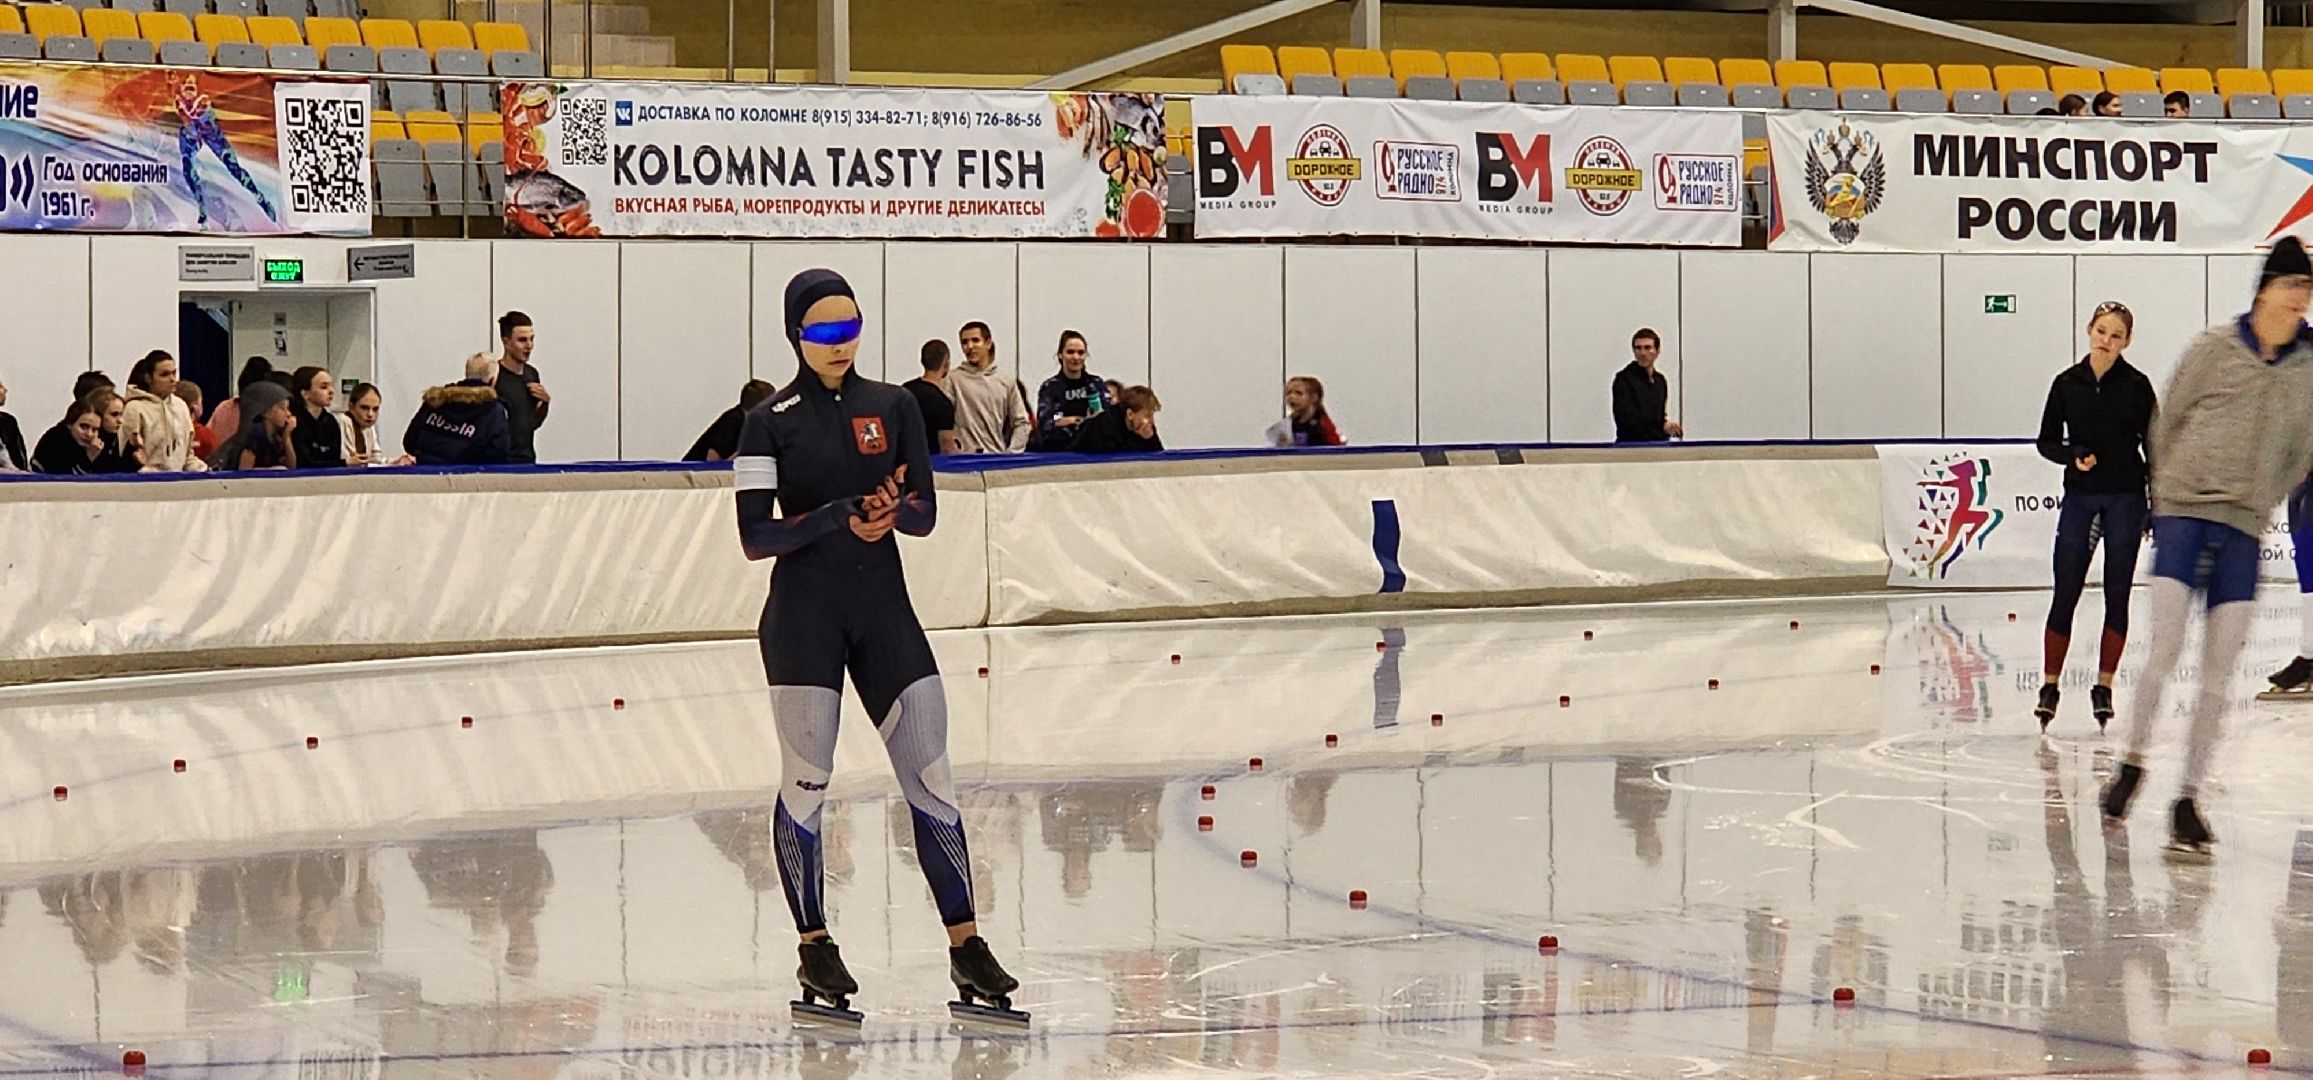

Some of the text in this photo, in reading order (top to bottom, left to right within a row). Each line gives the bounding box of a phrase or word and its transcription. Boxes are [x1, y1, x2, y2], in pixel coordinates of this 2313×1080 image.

[0, 85, 38, 118] ие
[637, 105, 1042, 128] ДОСТАВКА ПО КОЛОМНЕ 8(915) 334-82-71; 8(916) 726-86-56
[44, 156, 168, 183] Год основания
[614, 144, 1045, 190] KOLOMNA TASTY FISH
[1397, 148, 1444, 171] РУССКОЕ
[1914, 134, 2218, 183] МИНСПОРТ
[1678, 161, 1723, 182] РУССКОЕ
[41, 191, 95, 217] 1961 г.
[615, 198, 1045, 217] ВКУСНАЯ РЫБА, МОРЕПРОДУКТЫ И ДРУГИЕ ДЕЛИКАТЕСЫ
[1200, 200, 1277, 210] MEDIA GROUP
[1479, 204, 1553, 215] MEDIA GROUP
[1958, 197, 2177, 242] РОССИИ
[2015, 495, 2039, 512] ПО
